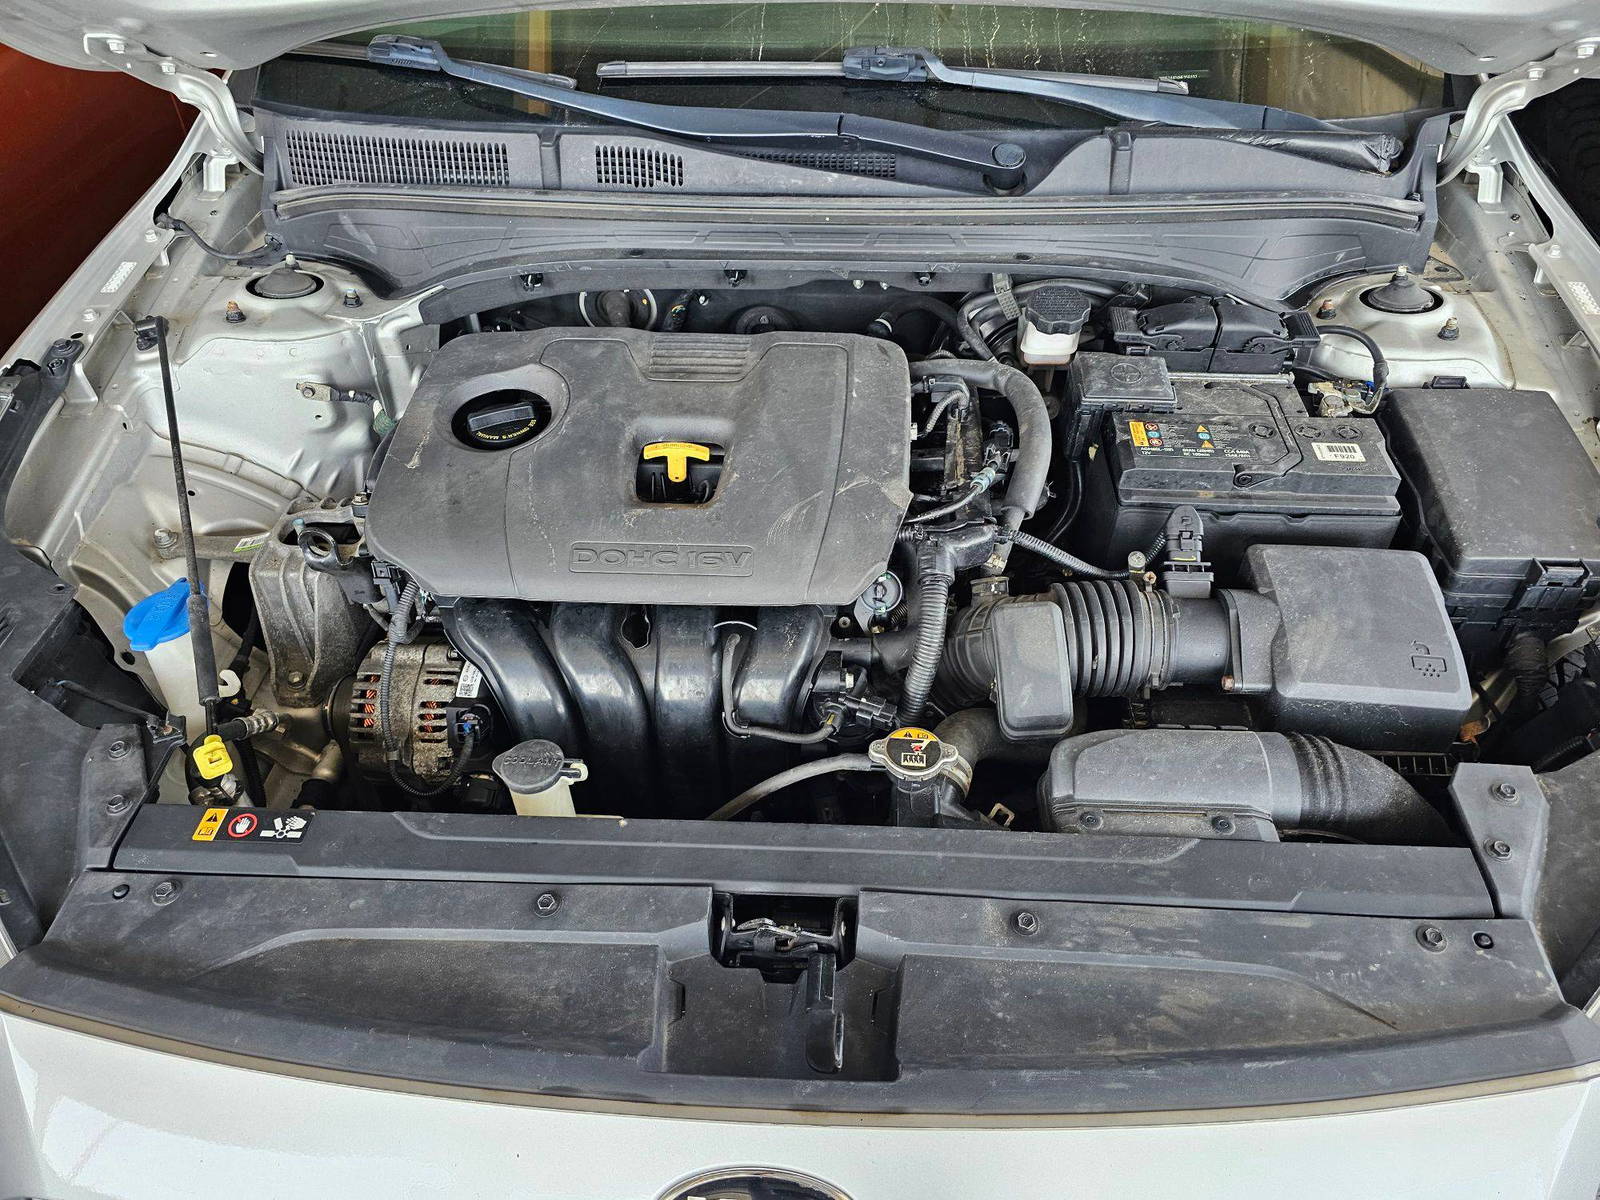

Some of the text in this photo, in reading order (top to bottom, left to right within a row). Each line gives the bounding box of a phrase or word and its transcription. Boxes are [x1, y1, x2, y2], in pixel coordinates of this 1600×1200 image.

[475, 430, 500, 439] MANUAL
[572, 548, 753, 569] DOHC 16V
[503, 754, 563, 767] COOLANT
